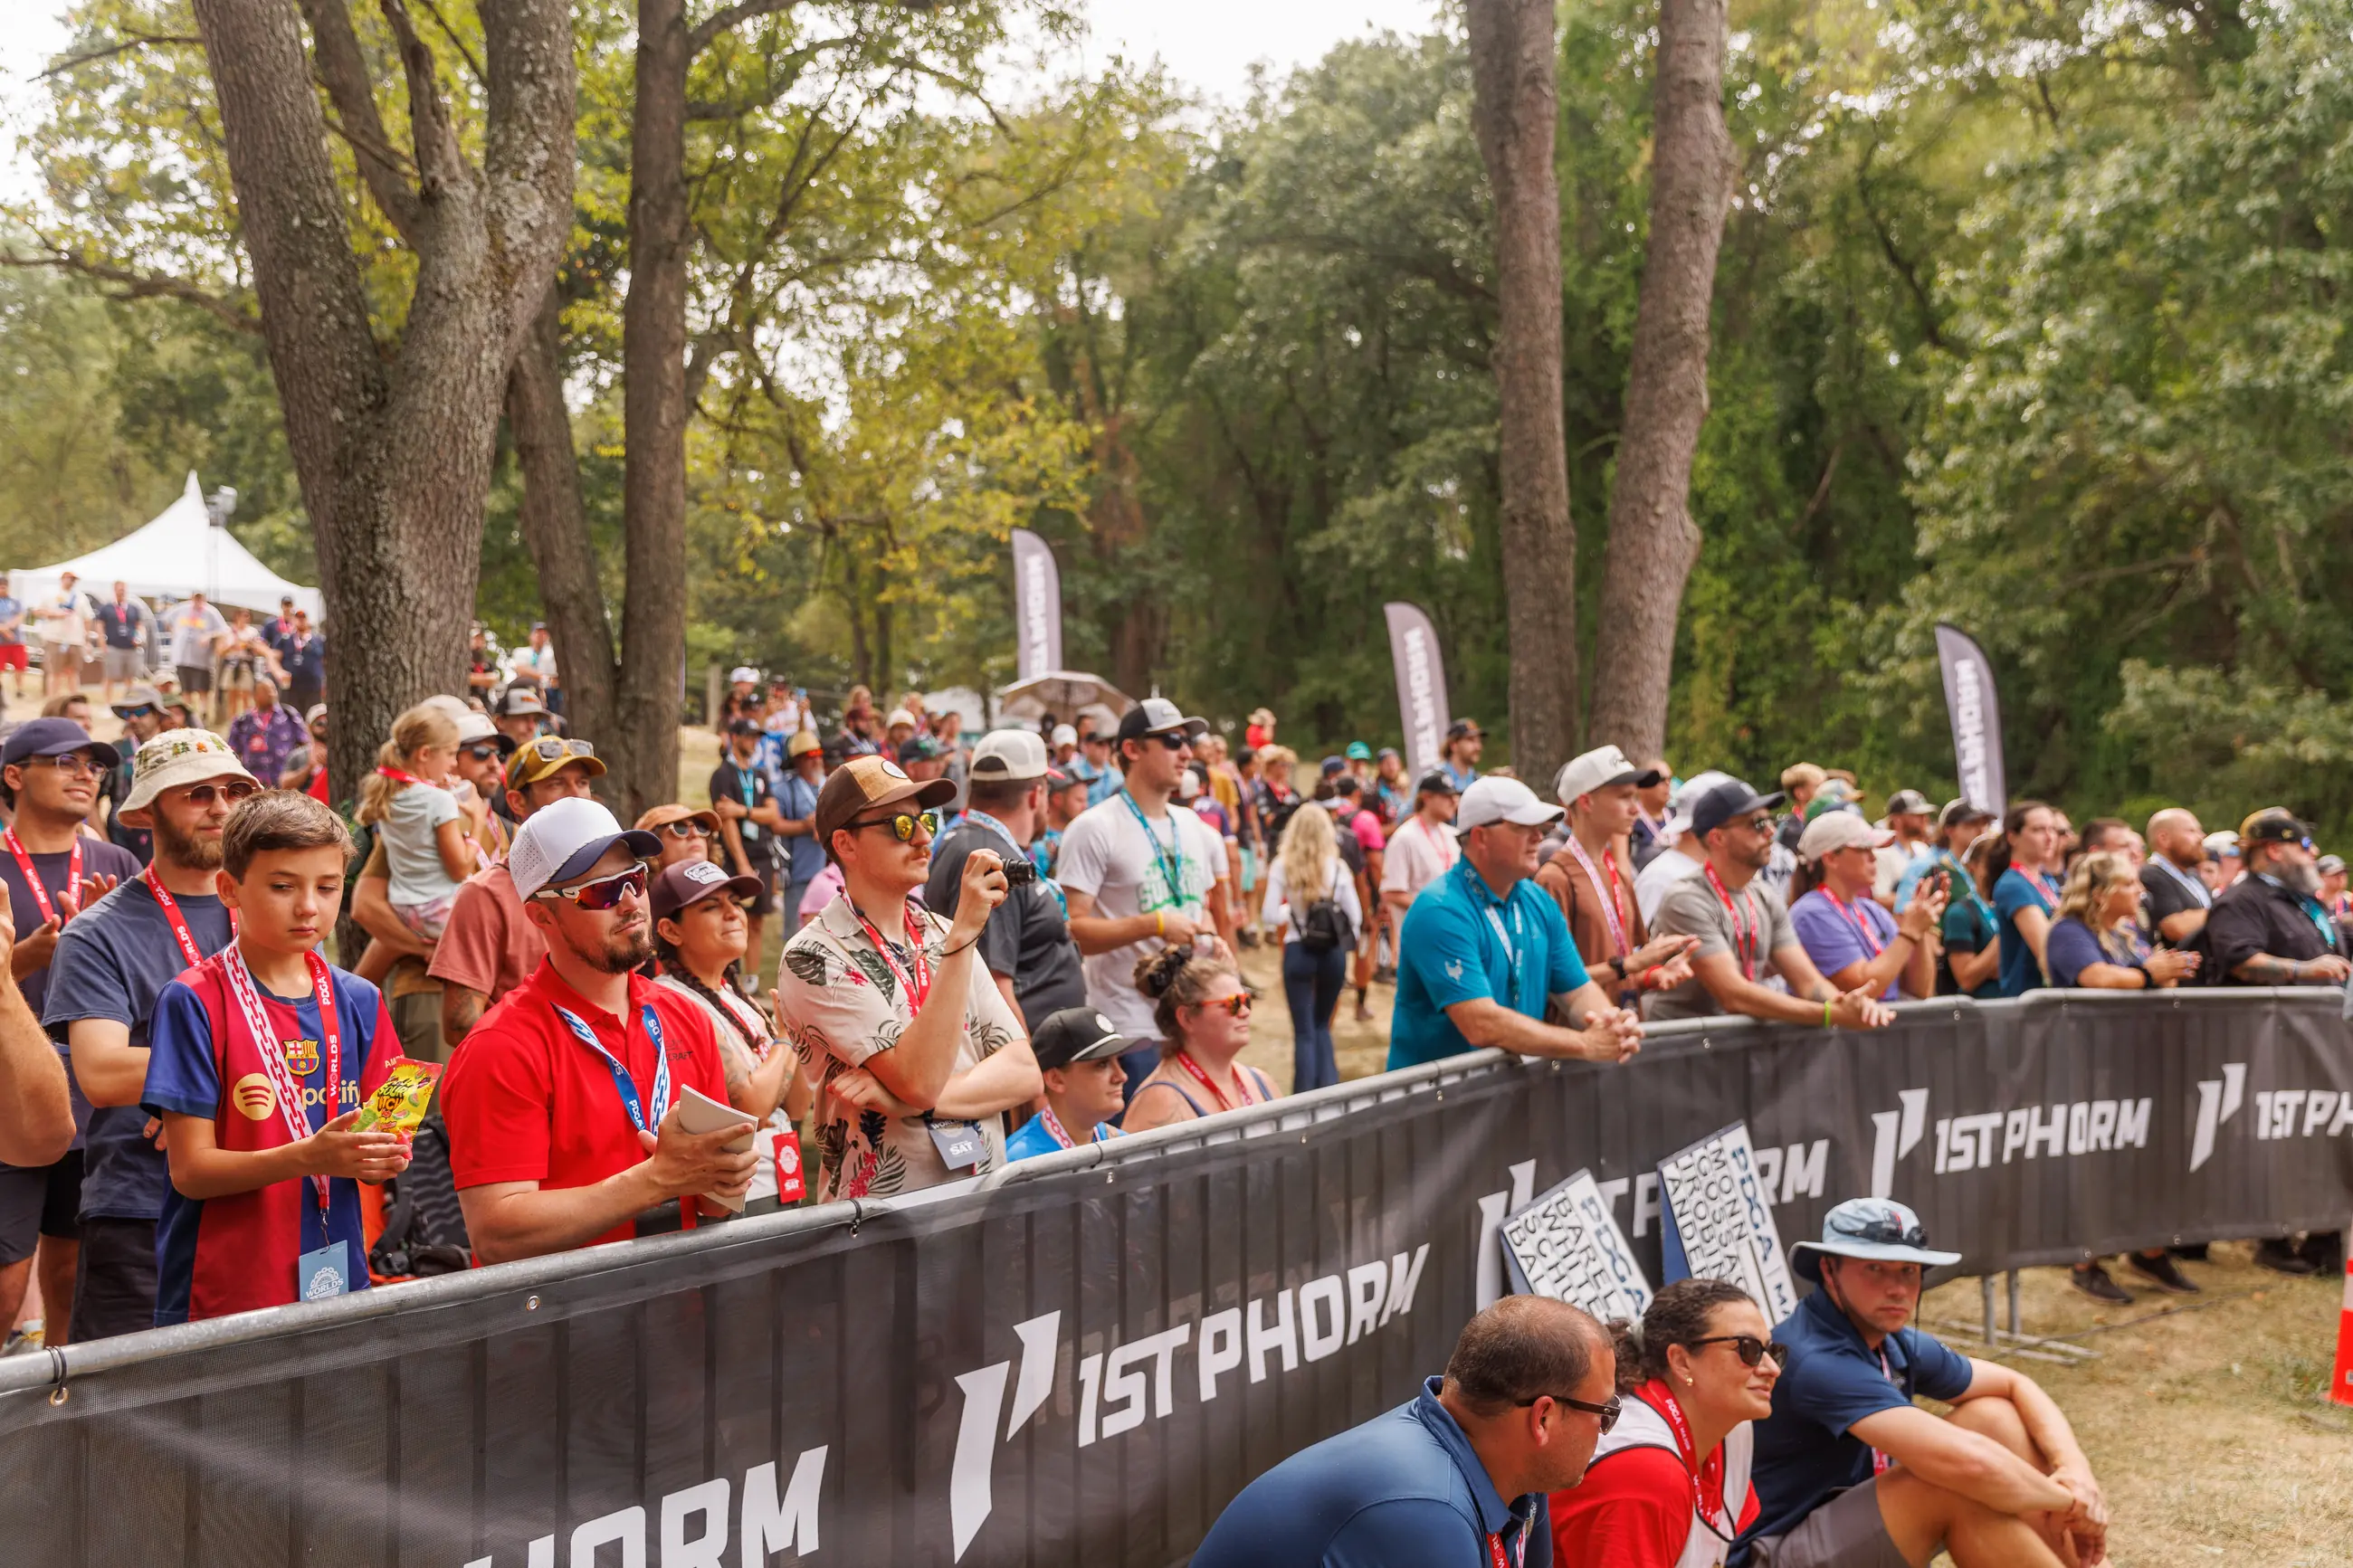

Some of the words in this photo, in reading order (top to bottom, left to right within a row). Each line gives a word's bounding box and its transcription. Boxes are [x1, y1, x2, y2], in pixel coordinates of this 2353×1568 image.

[176, 925, 201, 966] WORLDS
[317, 975, 331, 1005] PDGA
[329, 1034, 338, 1097] WORLDS
[628, 1099, 644, 1127] PDGA
[949, 1141, 974, 1155] SAT
[1711, 1145, 1749, 1242] MONN
[1731, 1145, 1774, 1263] PDGA
[1580, 1194, 1645, 1318] PDGA
[306, 1278, 344, 1298] WORLDS
[1664, 1398, 1682, 1426] PDGA
